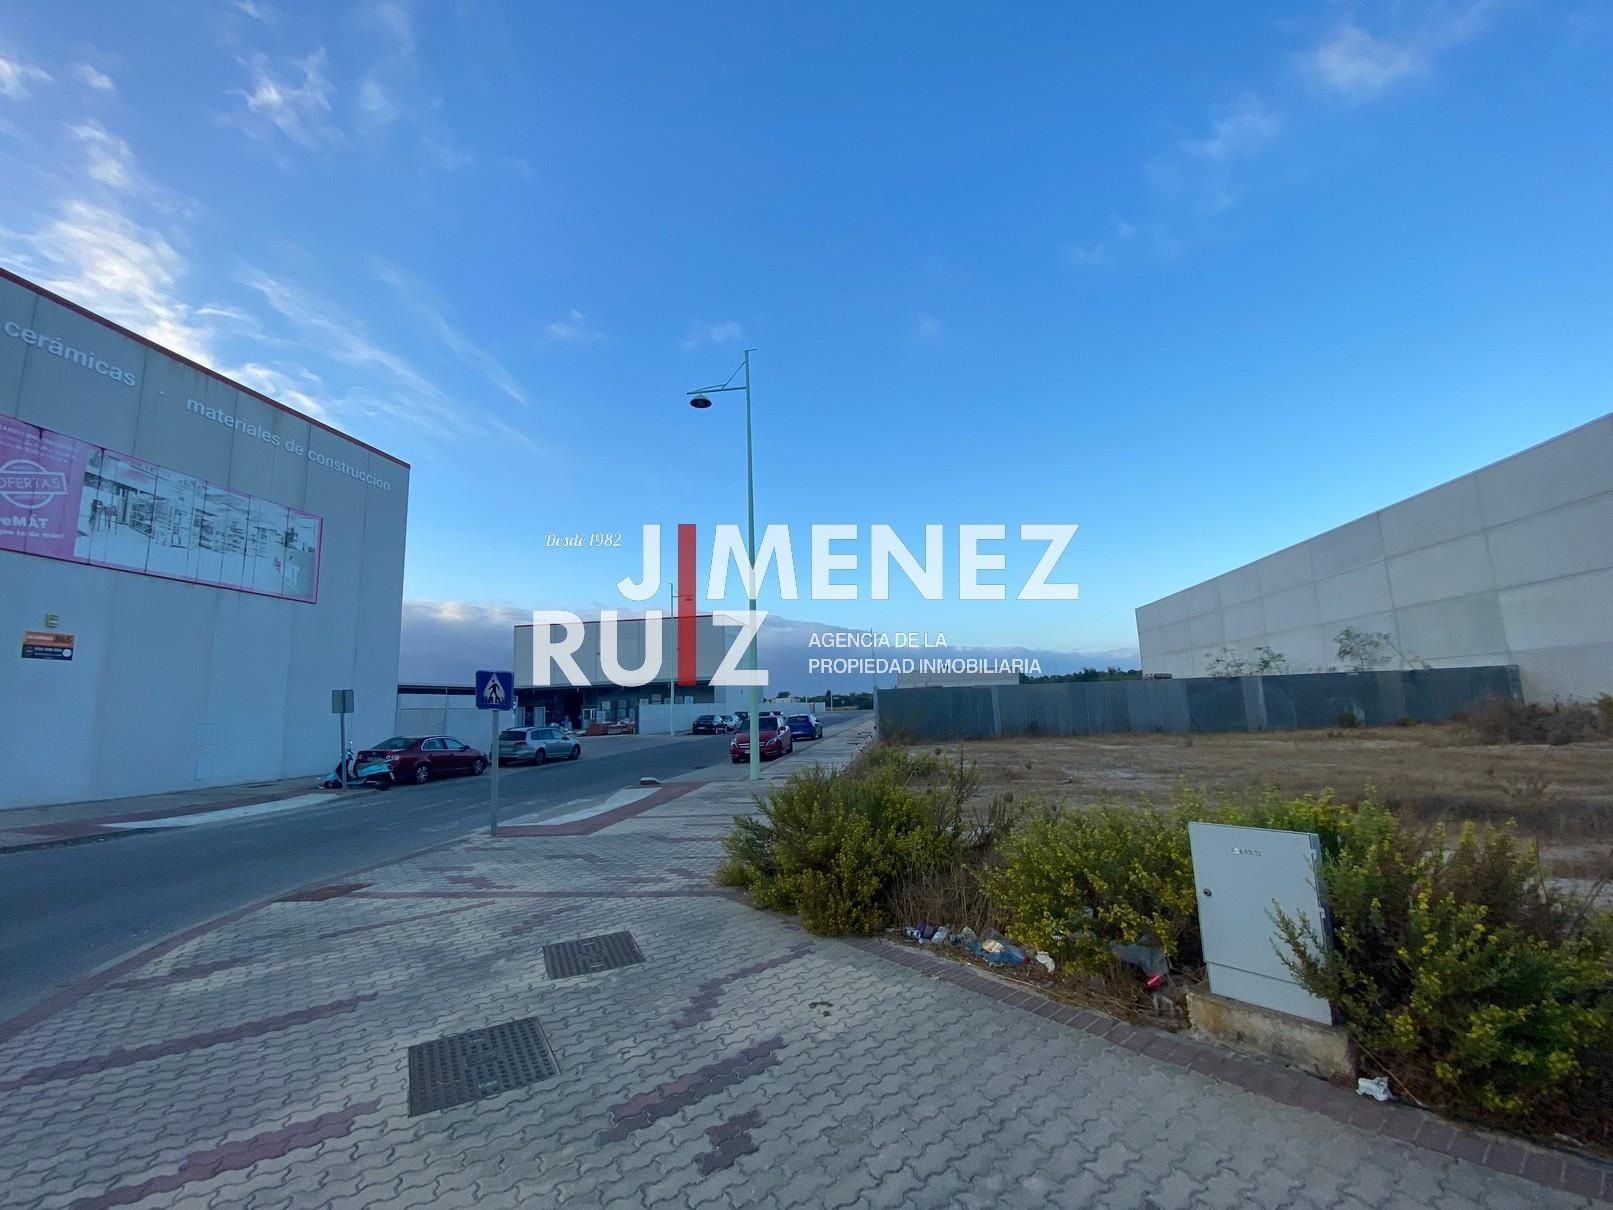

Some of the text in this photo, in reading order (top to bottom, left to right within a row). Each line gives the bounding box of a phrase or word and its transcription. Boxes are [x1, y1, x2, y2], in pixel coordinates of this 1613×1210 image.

[4, 320, 137, 387] cerámicas
[186, 397, 281, 447] materiales
[284, 438, 304, 456] de
[0, 477, 61, 489] OFERTAS
